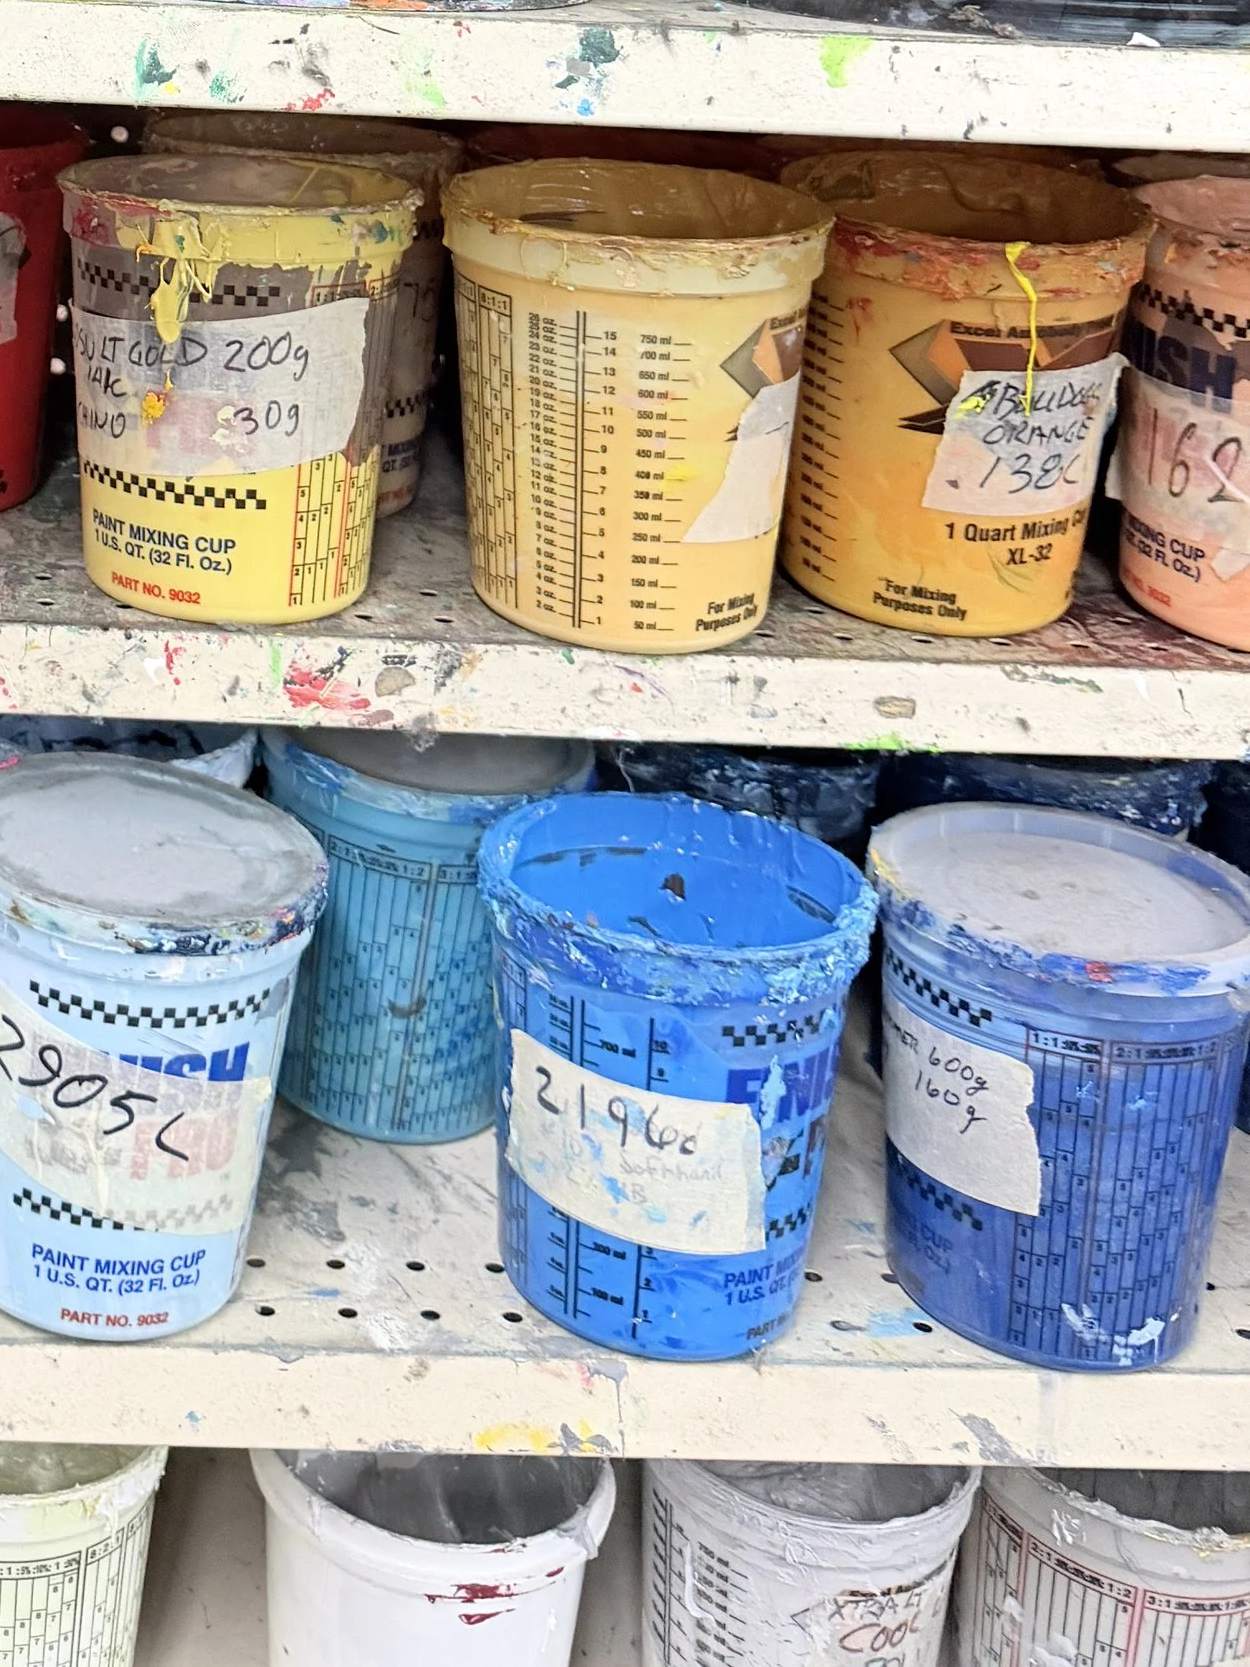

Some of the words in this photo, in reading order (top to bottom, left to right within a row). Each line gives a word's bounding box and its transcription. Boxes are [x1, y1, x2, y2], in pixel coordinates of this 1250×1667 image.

[223, 331, 309, 382] 200g
[93, 508, 126, 536] PAINT
[129, 523, 189, 550] MIXING
[195, 536, 236, 554] CUP
[964, 523, 1016, 542] Quart
[1021, 518, 1068, 540] Mixing
[1006, 543, 1053, 565] XL-32
[1170, 539, 1205, 562] CUP
[111, 572, 139, 593] PART
[143, 581, 166, 599] NO.
[169, 588, 200, 605] 9032
[32, 1243, 87, 1271] PAINT
[94, 1259, 165, 1276] MIXING
[170, 1250, 206, 1272] CUP
[47, 1272, 80, 1289] U.S.
[86, 1276, 113, 1292] QT.
[118, 1277, 143, 1296] (32
[724, 1264, 773, 1288] PAINT
[61, 1309, 101, 1324] PART
[106, 1313, 132, 1327] NO.
[137, 1312, 169, 1326] 9032
